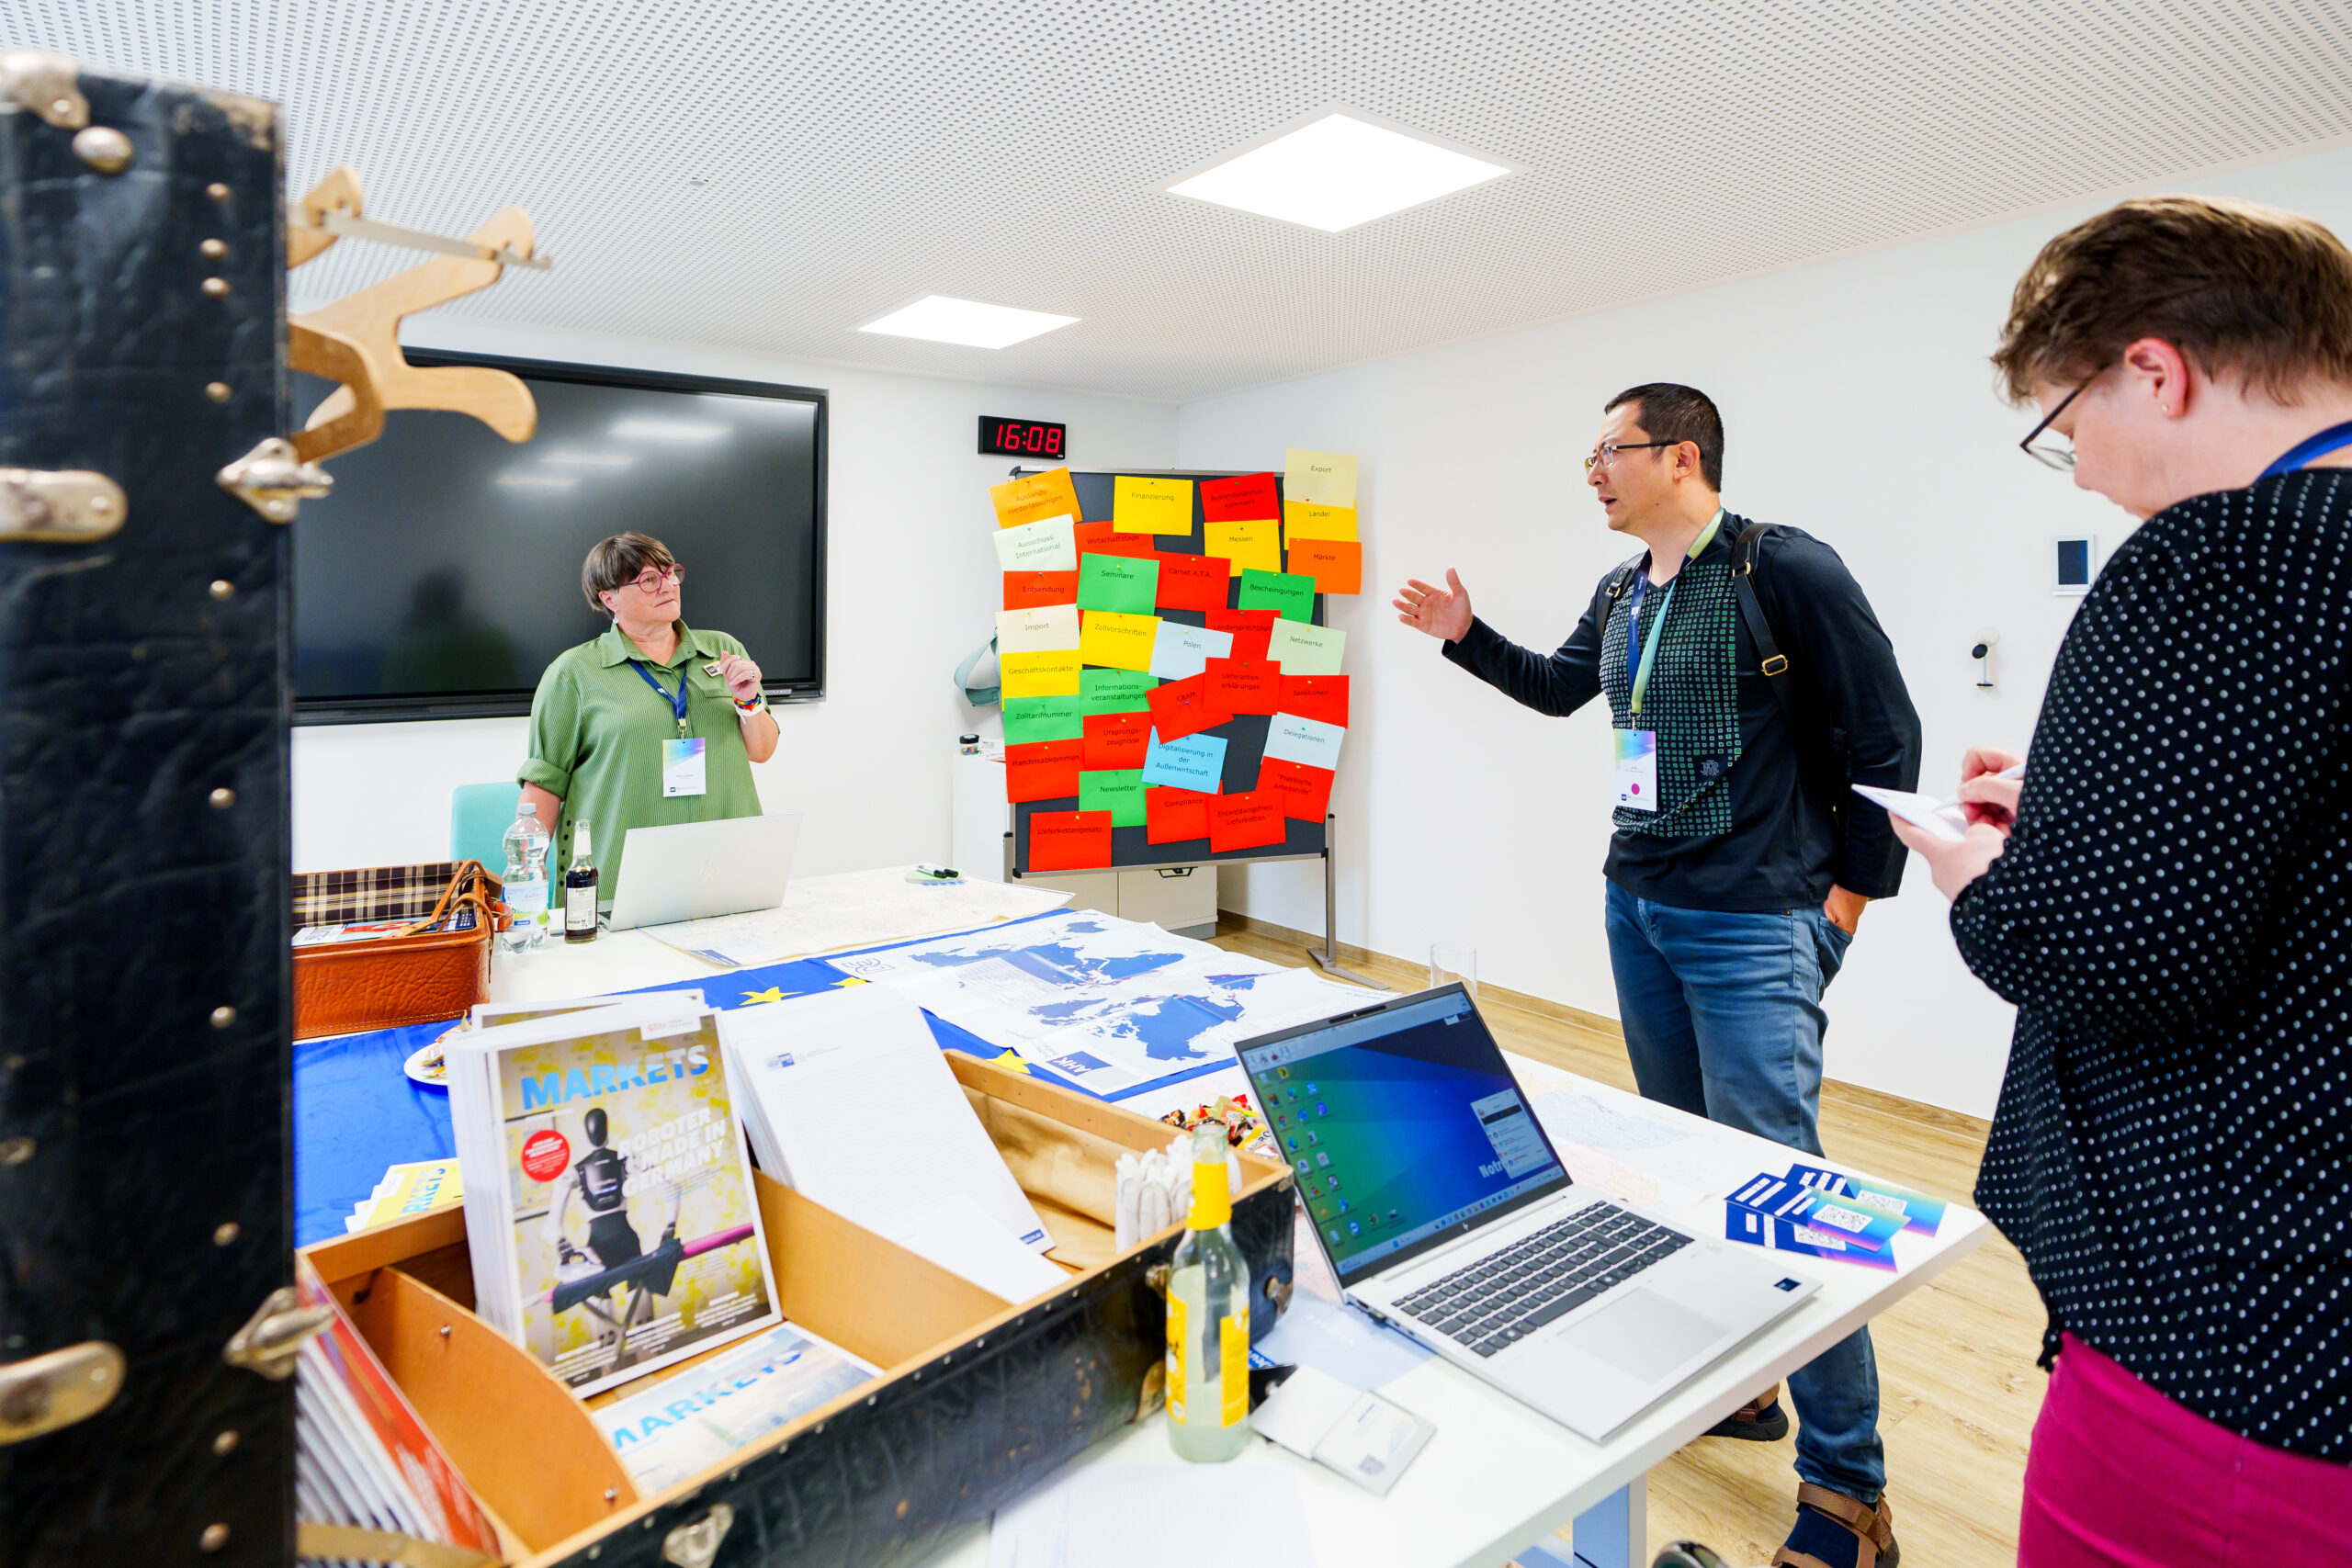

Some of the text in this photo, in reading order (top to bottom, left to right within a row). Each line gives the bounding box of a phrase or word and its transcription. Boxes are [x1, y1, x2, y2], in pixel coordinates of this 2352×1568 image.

[996, 424, 1062, 453] 16:08
[1310, 466, 1332, 474] Export
[1015, 489, 1048, 502] Auslands-
[1131, 492, 1175, 502] Finanzierung
[1007, 495, 1064, 514] niederlassungen
[1017, 535, 1055, 548] Ausschuss
[1086, 535, 1140, 545] Wirtschaftstage
[1015, 543, 1061, 558] International
[1101, 570, 1135, 580] Seminare
[1169, 568, 1213, 578] Carnet A.T.A.
[1250, 584, 1305, 596] Bescheinigungen
[1024, 623, 1049, 631] Import
[1094, 624, 1148, 637] Zollvorschriften
[1183, 640, 1202, 649] Polen
[1289, 636, 1324, 649] Netzwerke
[1008, 665, 1074, 675] Geschäftskontakte
[1222, 672, 1261, 681] Lieferanten-
[1094, 683, 1143, 692] Informations-
[1221, 682, 1261, 691] erklärungen
[1176, 691, 1196, 702] CBAM
[1015, 710, 1073, 720] Zolltarifnummer
[1102, 728, 1141, 737] Ursprungs-
[1283, 728, 1326, 744] Delegationen
[1105, 737, 1140, 747] zeugnisse
[1158, 743, 1205, 758] Digitalisierung
[1012, 754, 1080, 767] Handelsabkommen
[1155, 762, 1209, 777] Außenwirtschaft
[1100, 784, 1137, 793] Newsletter
[1164, 797, 1204, 807] Compliance
[1051, 1056, 1092, 1073] AHK
[521, 1044, 709, 1111] MARKETS
[616, 1107, 711, 1159] ROBOTER
[641, 1129, 701, 1171] MADE
[705, 1119, 726, 1143] IN
[622, 1138, 725, 1198] GERMANY
